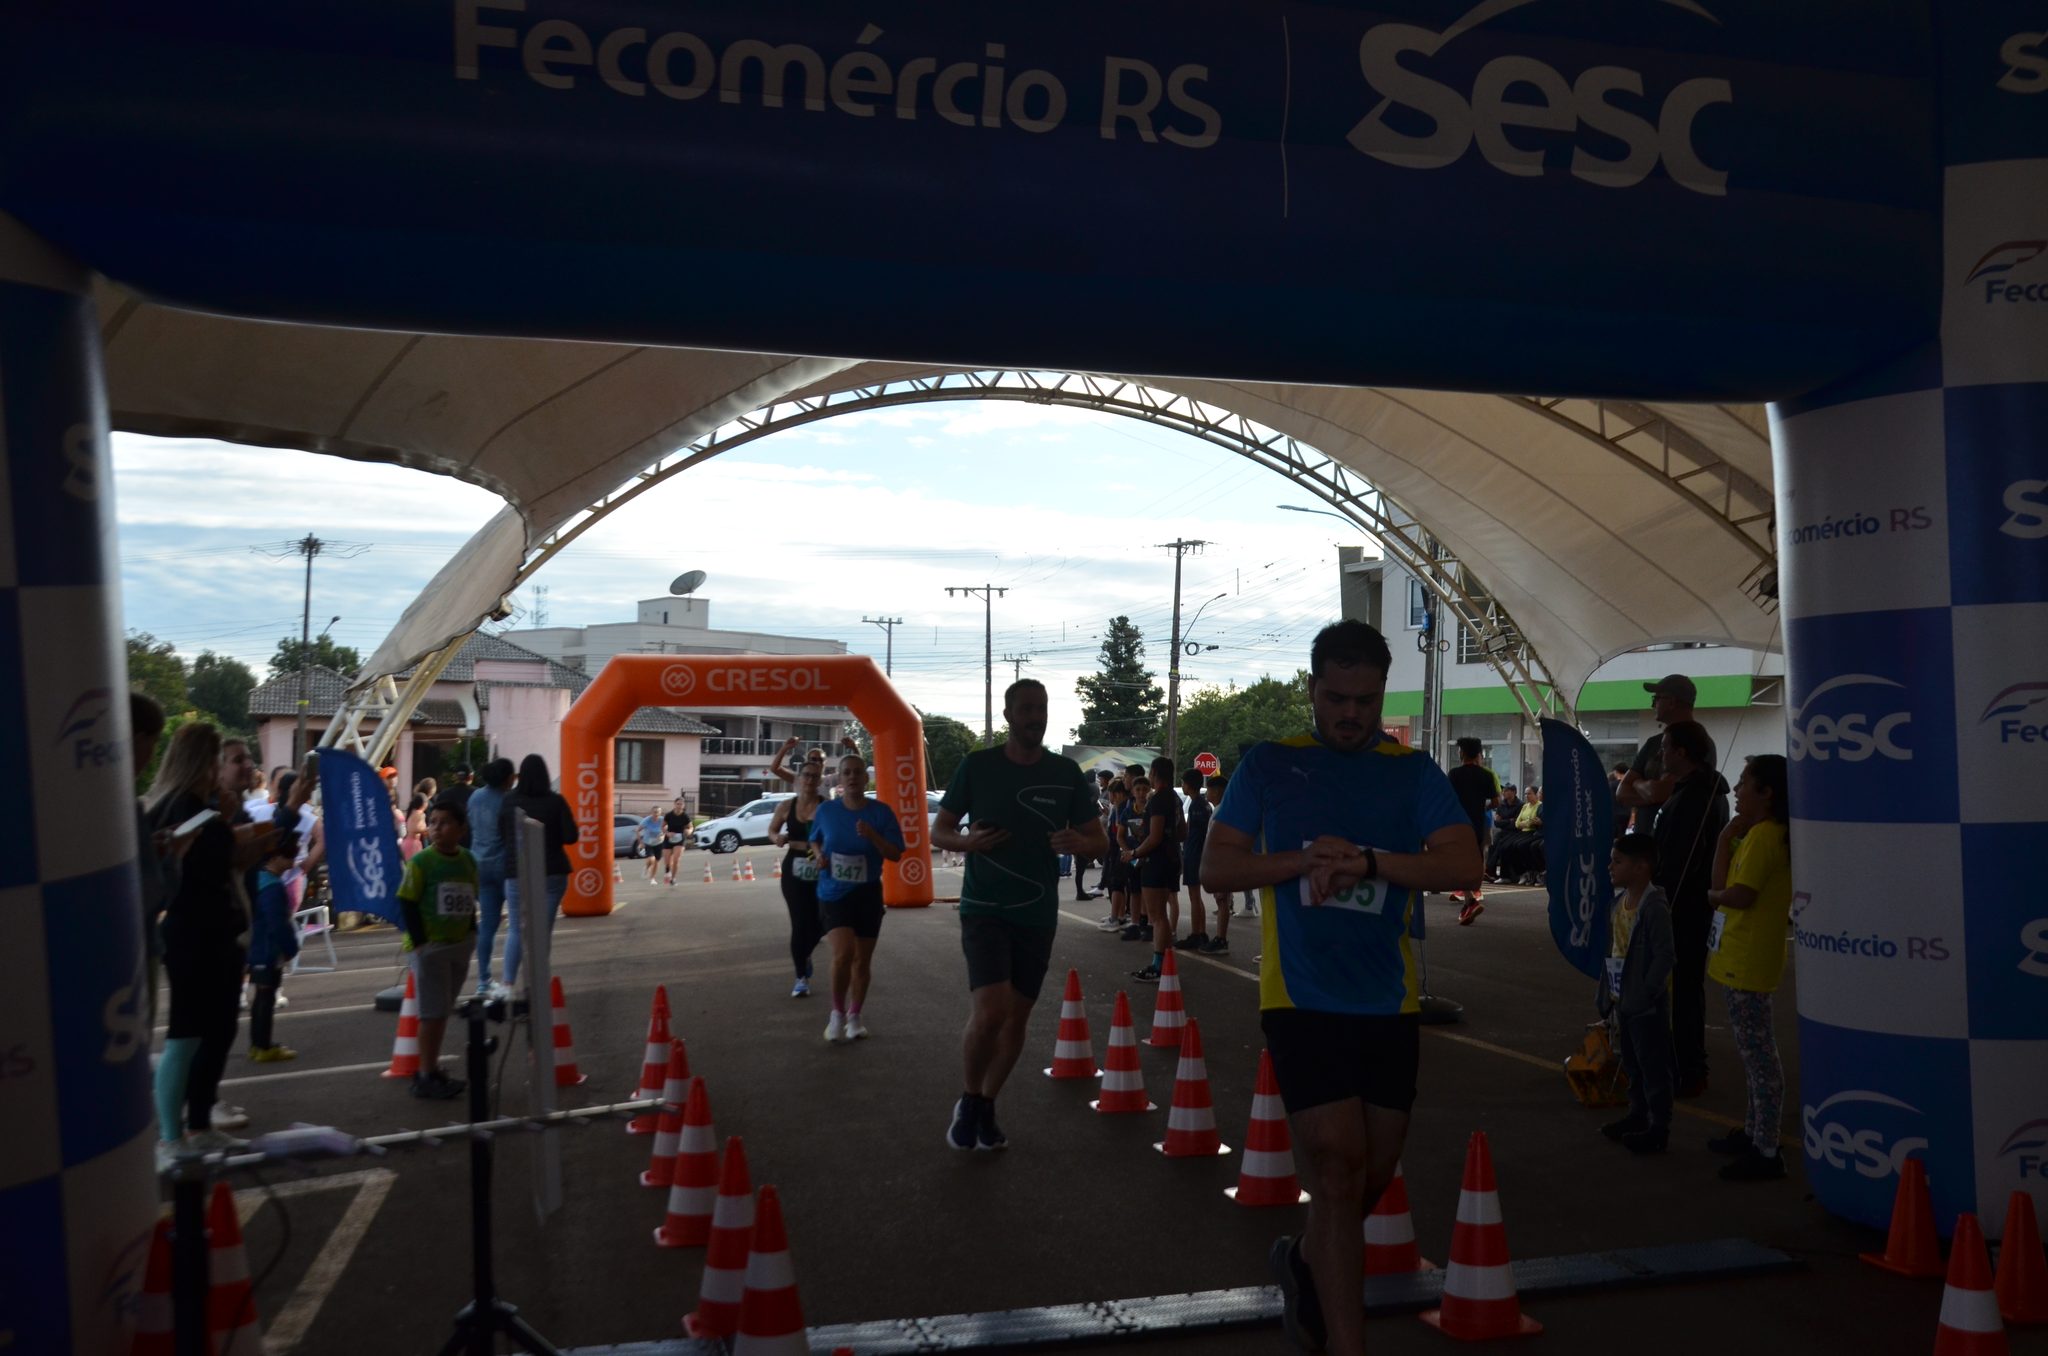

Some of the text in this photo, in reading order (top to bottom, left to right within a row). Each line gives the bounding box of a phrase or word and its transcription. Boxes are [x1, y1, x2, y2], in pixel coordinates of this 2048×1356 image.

[453, 0, 1222, 149] Fecomércio RS
[1345, 22, 1733, 196] Sesc
[1889, 506, 1932, 532] RS
[706, 668, 831, 692] CRESOL
[1196, 760, 1216, 769] PARE
[577, 754, 600, 860] CRESOL
[896, 746, 921, 849] CRESOL
[835, 864, 862, 880] 347
[1907, 936, 1950, 961] RS
